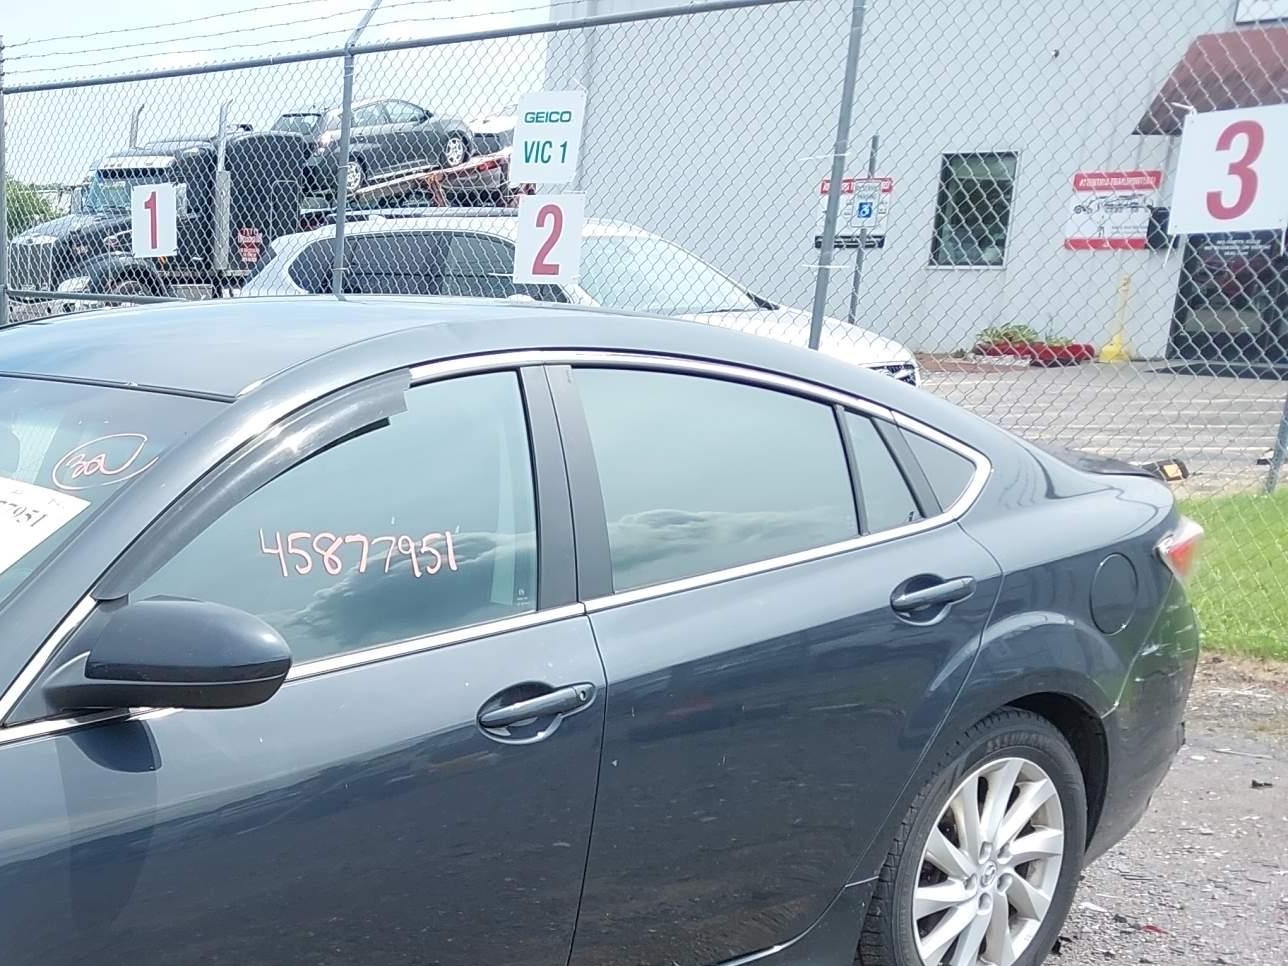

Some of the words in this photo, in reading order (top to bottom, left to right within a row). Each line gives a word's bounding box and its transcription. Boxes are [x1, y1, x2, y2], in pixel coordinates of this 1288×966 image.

[524, 110, 572, 124] GEICO
[524, 140, 553, 164] VIC
[559, 140, 569, 164] 1
[1206, 119, 1265, 221] 3
[143, 190, 159, 250] 1
[531, 203, 564, 276] 2
[259, 527, 459, 578] 45877951
